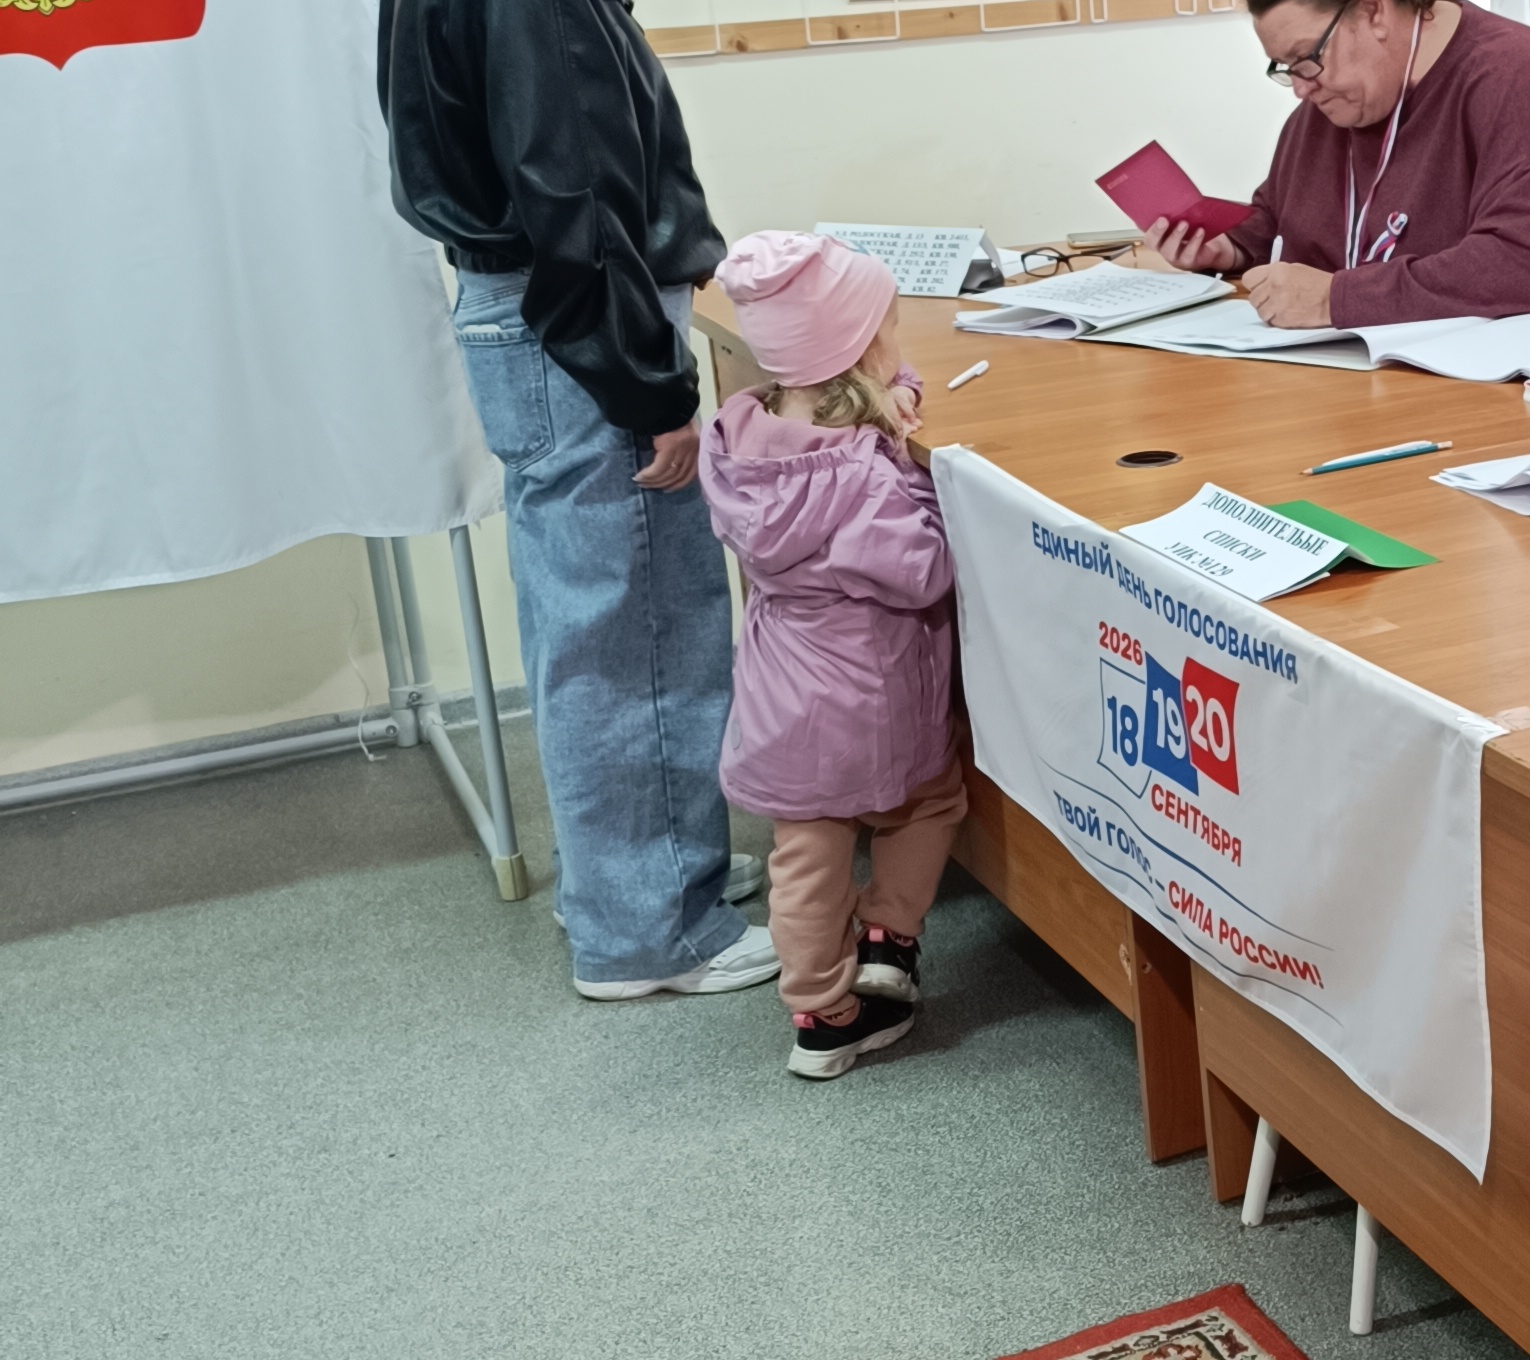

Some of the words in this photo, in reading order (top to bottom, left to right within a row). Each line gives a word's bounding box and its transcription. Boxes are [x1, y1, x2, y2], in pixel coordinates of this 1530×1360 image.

[1201, 491, 1329, 556] ДОПОЛНИТЕЛЬЫЕ
[1203, 529, 1267, 562] СПИСКИ
[1032, 521, 1114, 580] ЕДИНЫЙ
[1115, 559, 1152, 610] ДЕНЬ
[1154, 587, 1298, 684] ГОЛОСОВАНИЯ
[1099, 620, 1144, 667] 2026
[1107, 695, 1139, 767] 18
[1152, 687, 1186, 760] 19
[1185, 684, 1231, 763] 20
[1151, 783, 1241, 868] СЕНТЯБРЯ
[1053, 789, 1102, 841] ТВОЙ
[1168, 880, 1214, 940] СИЛА
[1218, 917, 1324, 991] РОССИИ!
